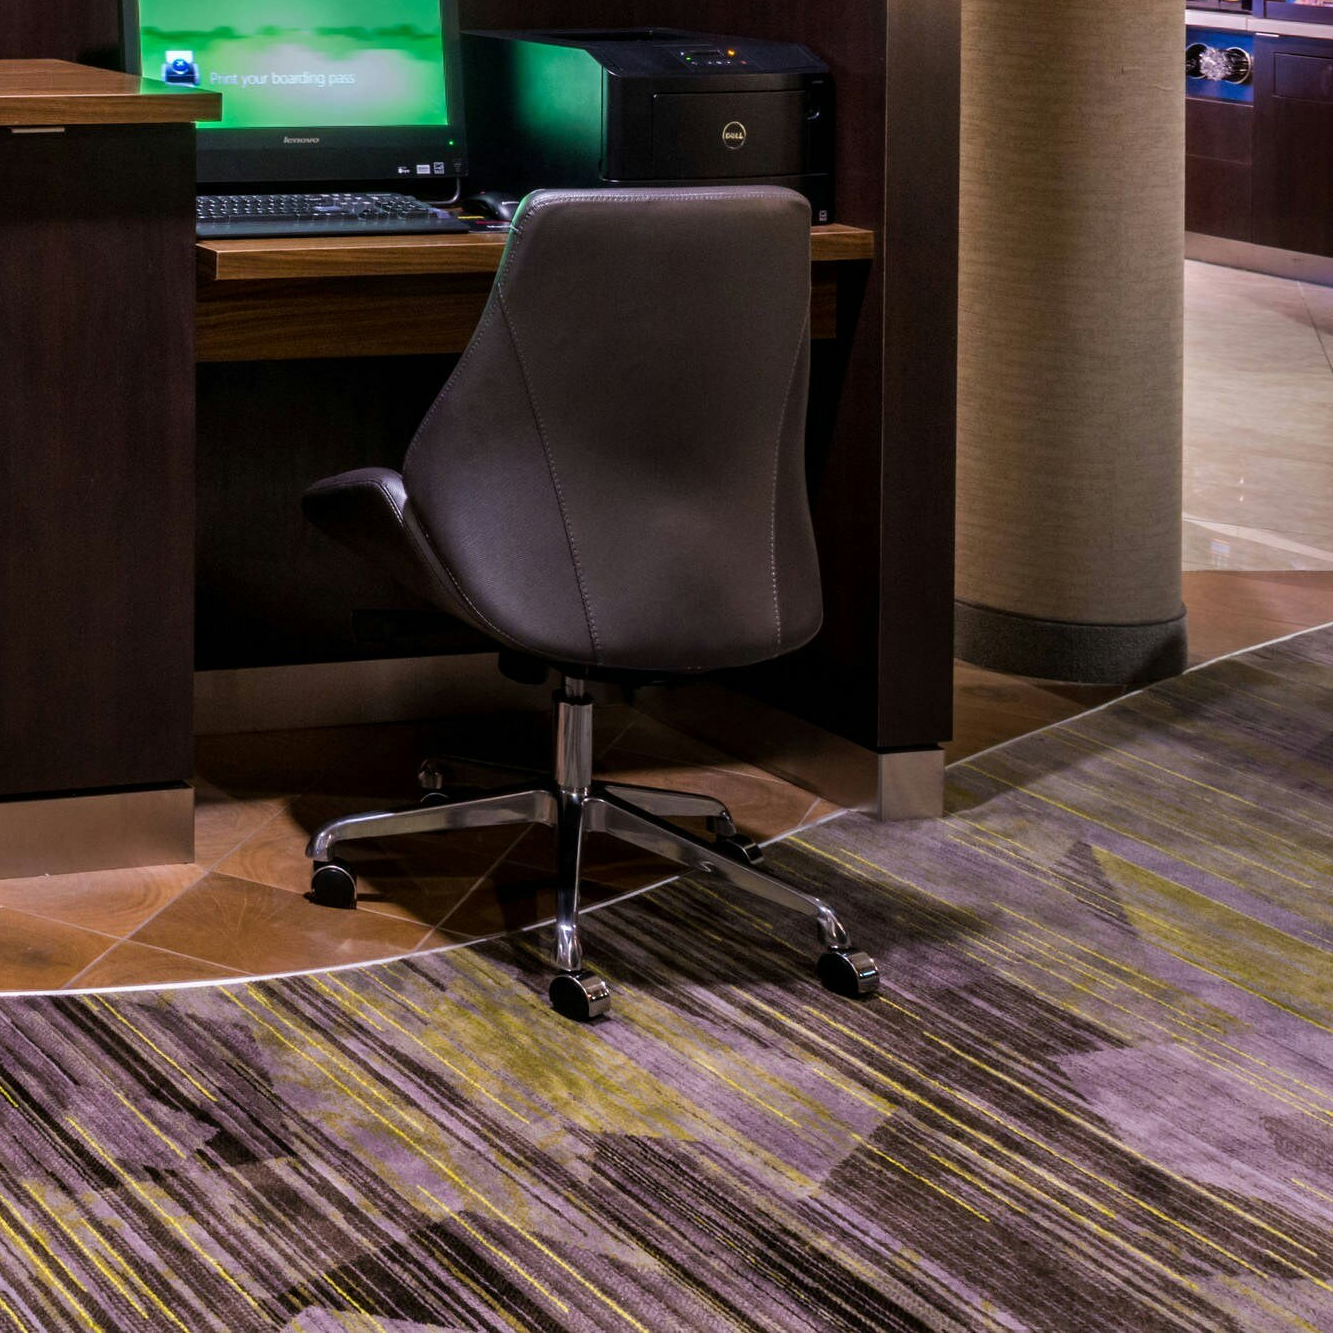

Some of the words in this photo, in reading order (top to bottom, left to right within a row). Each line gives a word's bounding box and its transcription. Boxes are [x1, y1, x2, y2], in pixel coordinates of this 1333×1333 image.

[210, 72, 238, 85] Print
[242, 74, 268, 88] your
[271, 71, 326, 88] boarding
[328, 73, 356, 87] pass
[283, 136, 320, 144] lenovo
[725, 132, 744, 140] DELL
